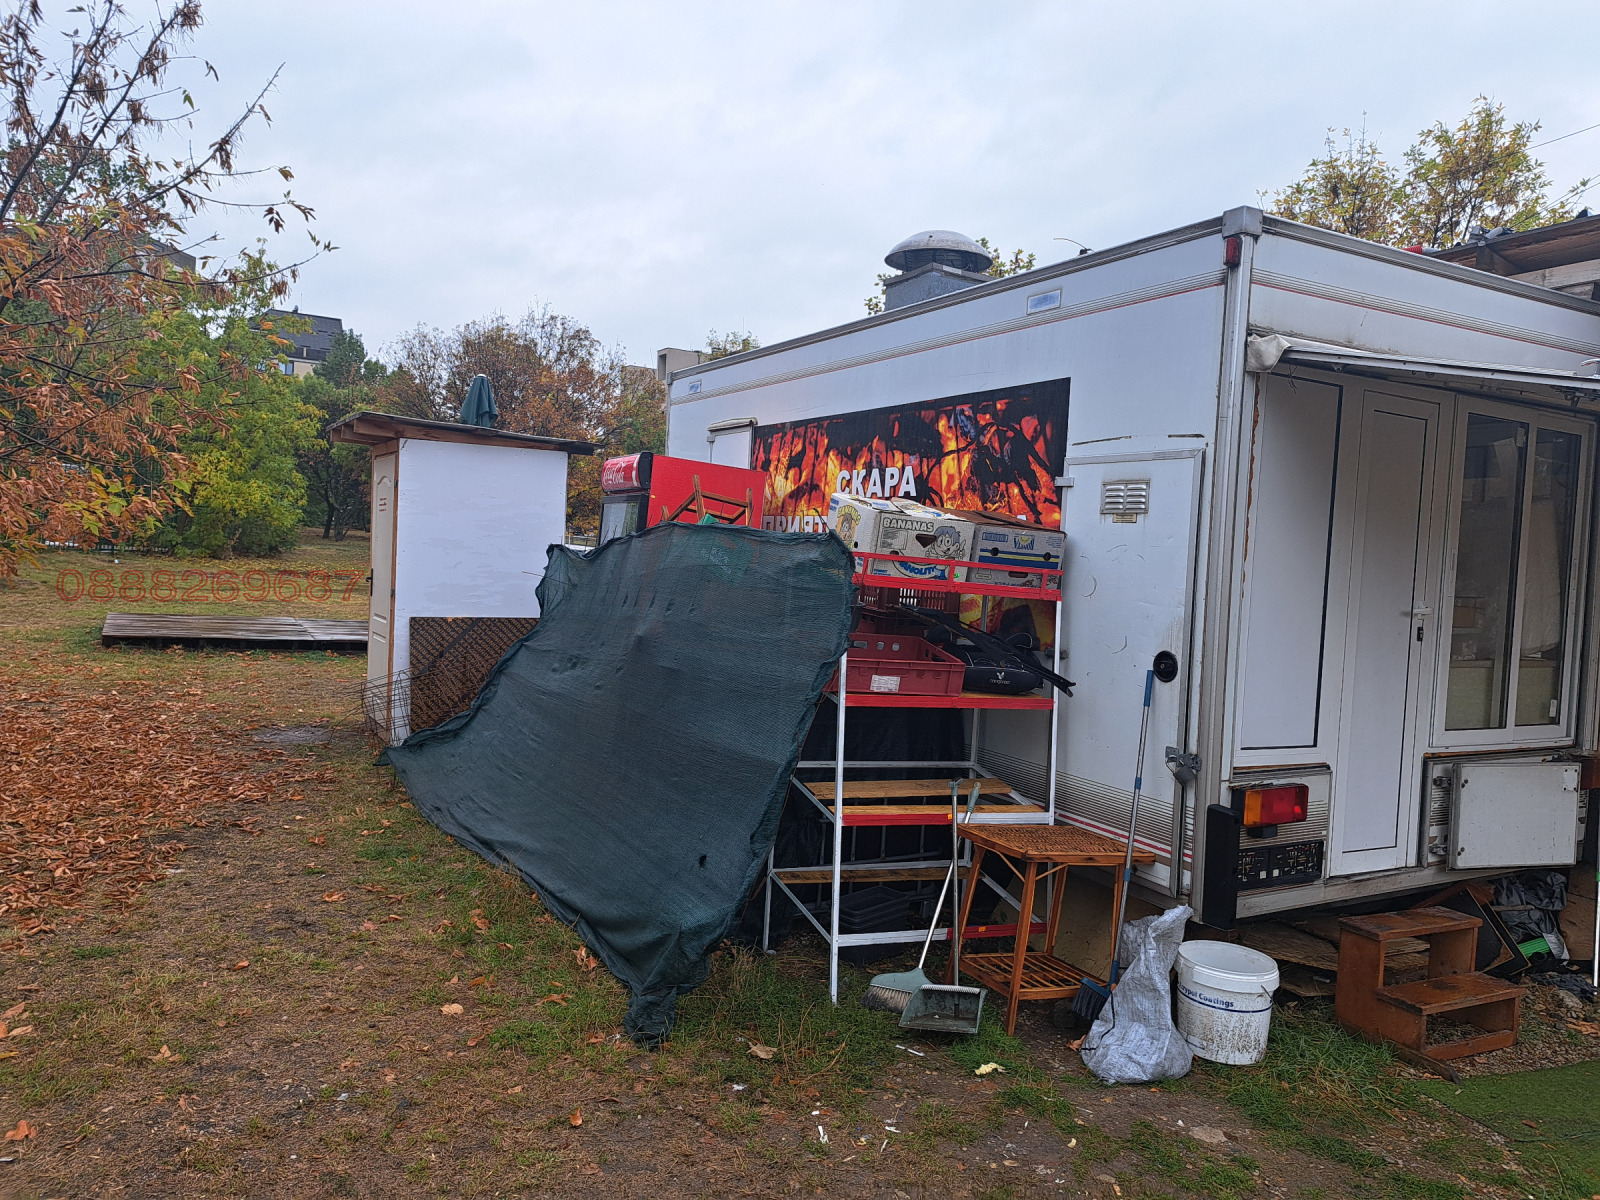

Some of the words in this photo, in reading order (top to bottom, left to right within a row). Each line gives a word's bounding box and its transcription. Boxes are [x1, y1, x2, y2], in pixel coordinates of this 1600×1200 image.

[836, 465, 917, 498] СКАРА
[882, 516, 934, 533] BANANAS
[1198, 992, 1235, 1009] Coatings
